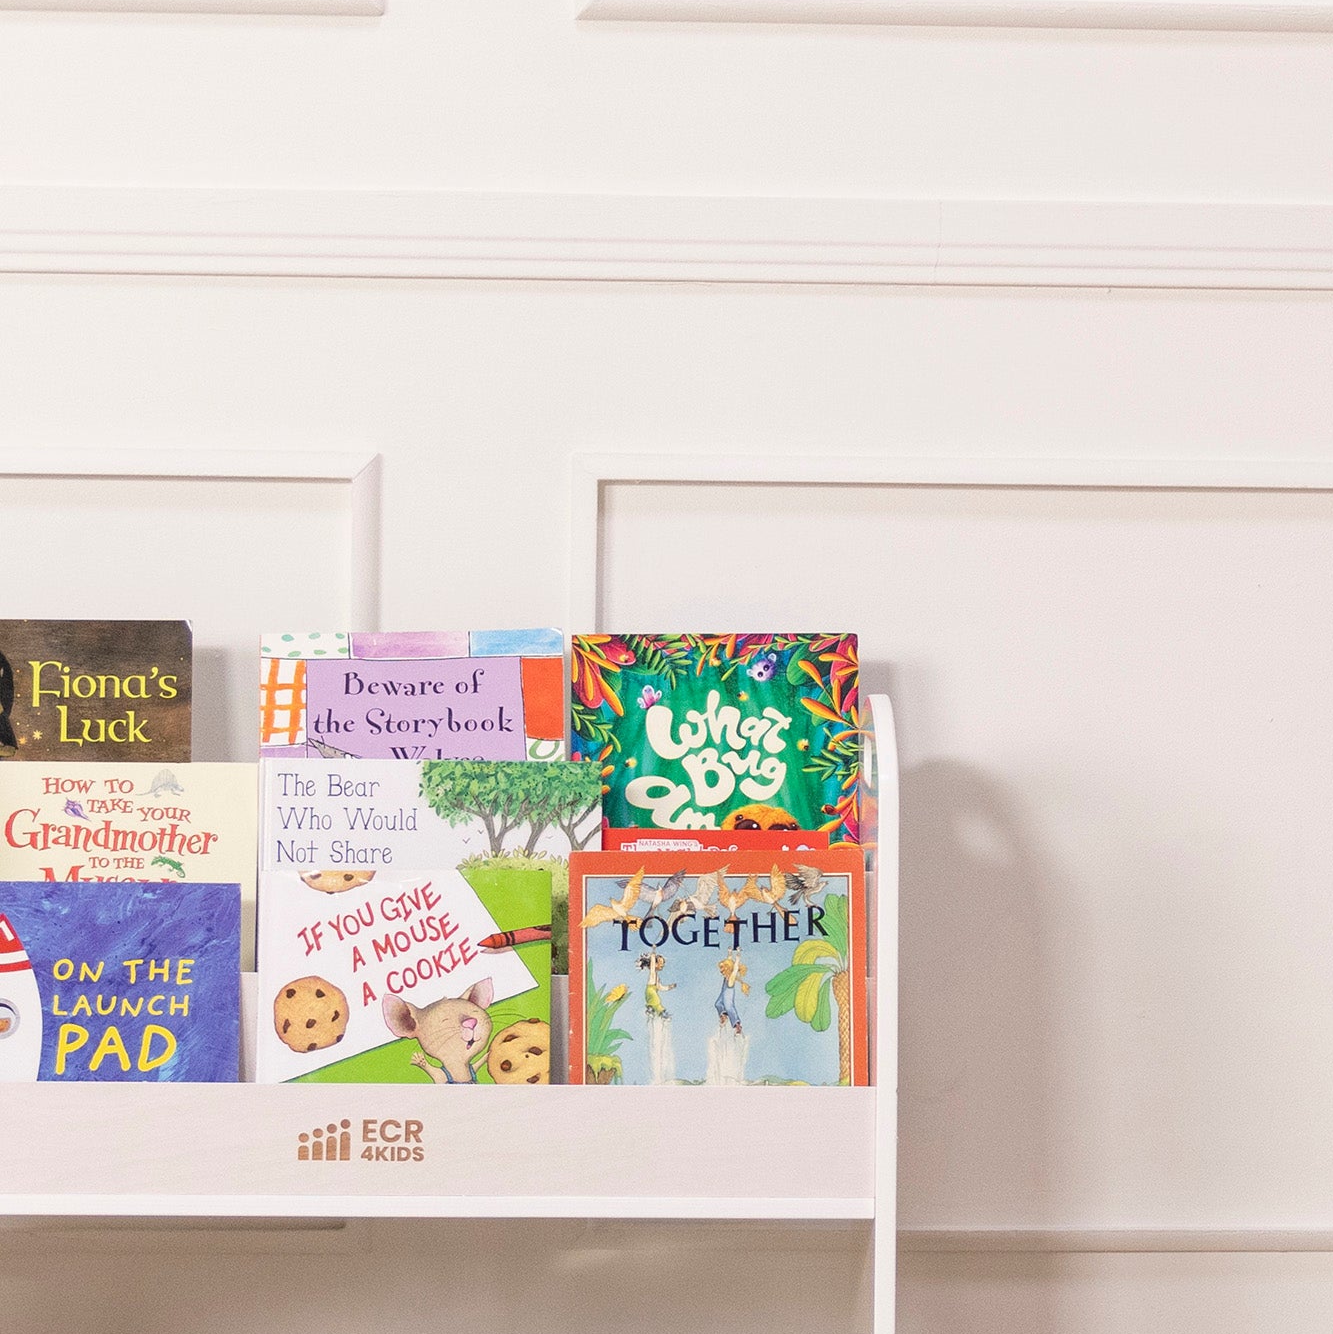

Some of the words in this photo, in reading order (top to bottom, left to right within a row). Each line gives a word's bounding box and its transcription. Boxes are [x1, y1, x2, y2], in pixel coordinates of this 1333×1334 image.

[29, 660, 178, 707] Fiona's
[343, 671, 445, 697] Beware
[455, 668, 485, 694] of
[56, 705, 152, 747] Luck
[313, 708, 355, 734] the
[365, 707, 514, 738] Storybook
[277, 773, 316, 797] The
[327, 773, 380, 797] Bear
[681, 747, 787, 807] Bug
[87, 799, 134, 814] TAKE
[137, 807, 192, 824] YOUR
[277, 806, 333, 831] Who
[343, 807, 418, 832] Would
[5, 808, 218, 855] Grandmother
[89, 856, 110, 869] TO
[113, 857, 145, 869] THE
[276, 840, 318, 864] Not
[329, 840, 393, 864] Share
[297, 921, 324, 956] IF
[327, 901, 375, 942] YOU
[380, 881, 442, 923] GIVE
[613, 905, 828, 951] TOGETHER
[352, 945, 366, 973] A
[372, 912, 460, 963] MOUSE
[53, 958, 105, 982] ON
[123, 958, 195, 985] THE
[362, 981, 377, 1006] A
[385, 937, 480, 995] COOKIE
[52, 994, 190, 1017] LAUNCH
[55, 1023, 177, 1075] PAD
[361, 1119, 424, 1143] ECR
[360, 1146, 425, 1162] 4KIDS
